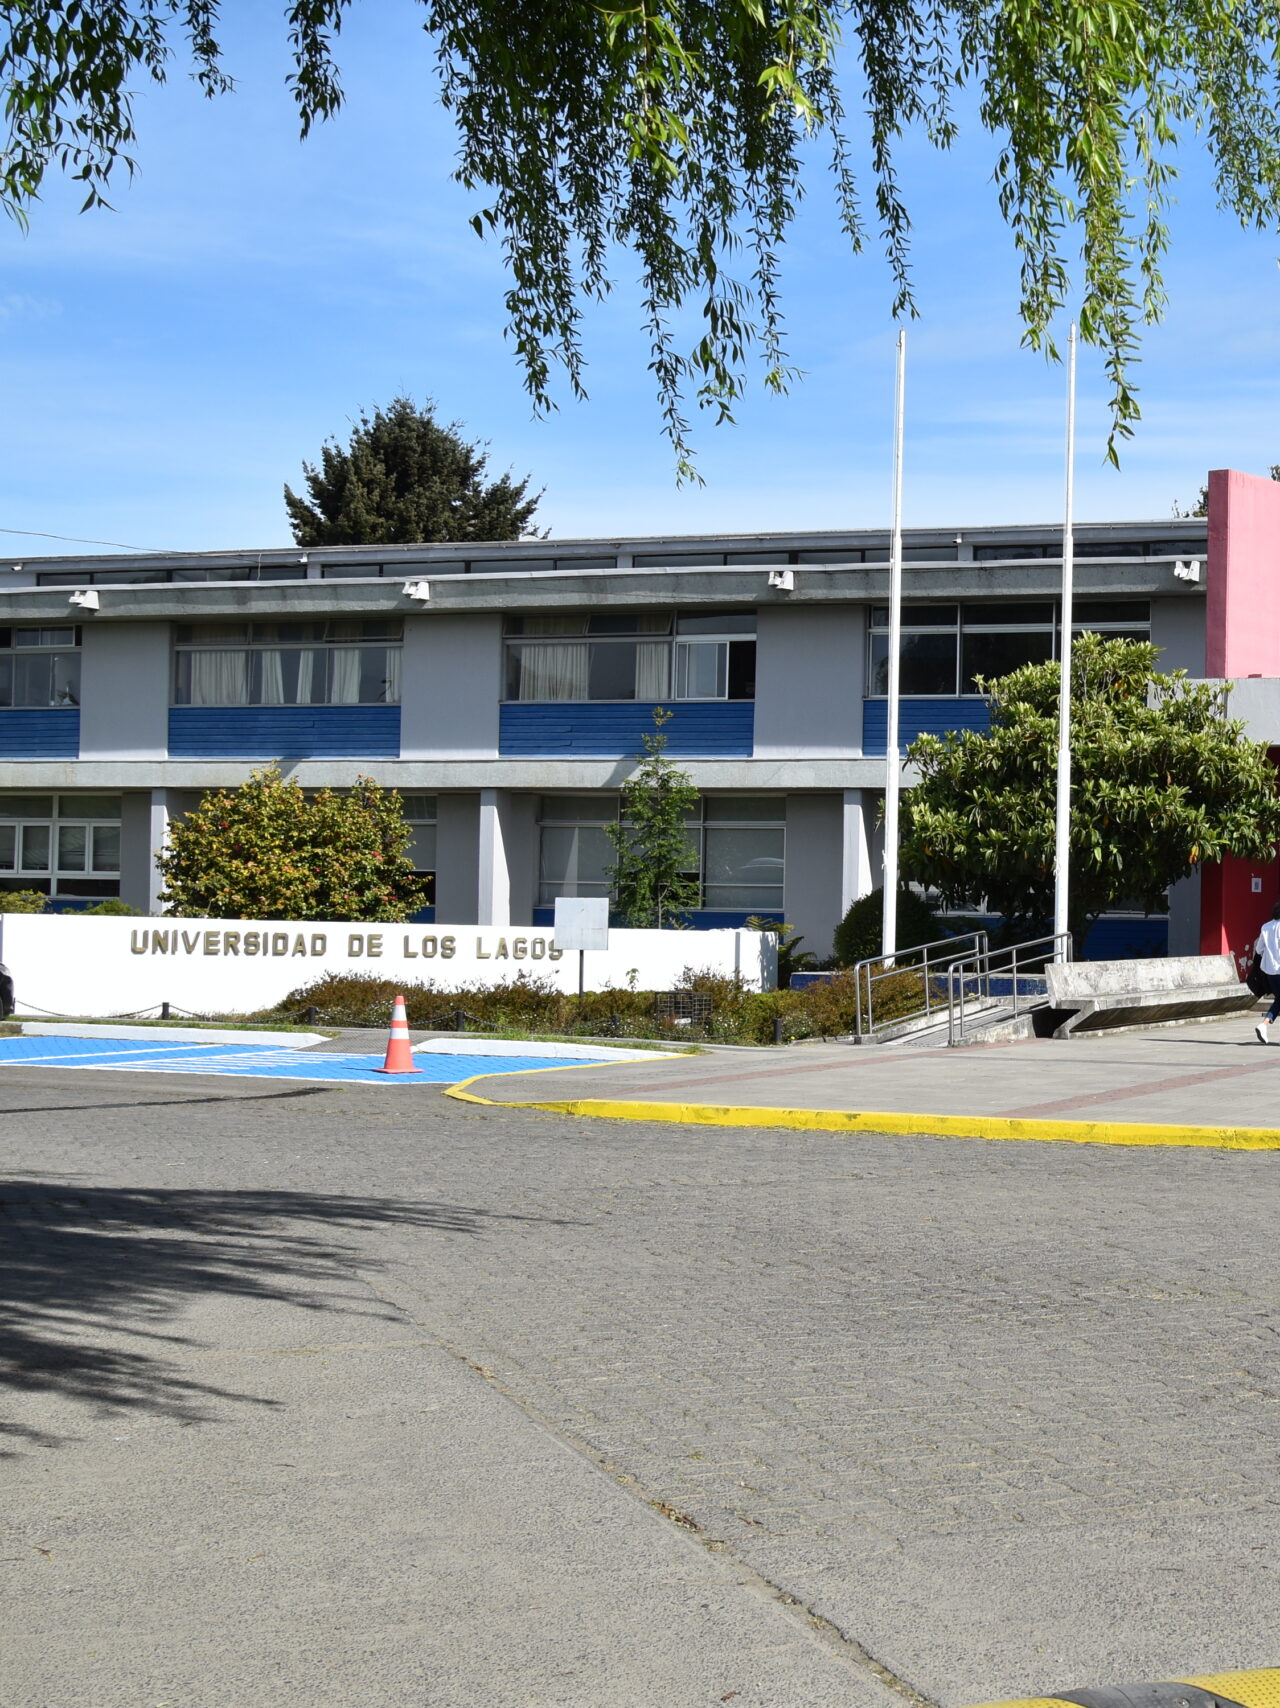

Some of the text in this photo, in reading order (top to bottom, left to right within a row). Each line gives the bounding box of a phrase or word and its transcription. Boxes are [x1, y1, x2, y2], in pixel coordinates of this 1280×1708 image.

[130, 929, 564, 961] UNIVERSIDAD DE LOS LAGOS
